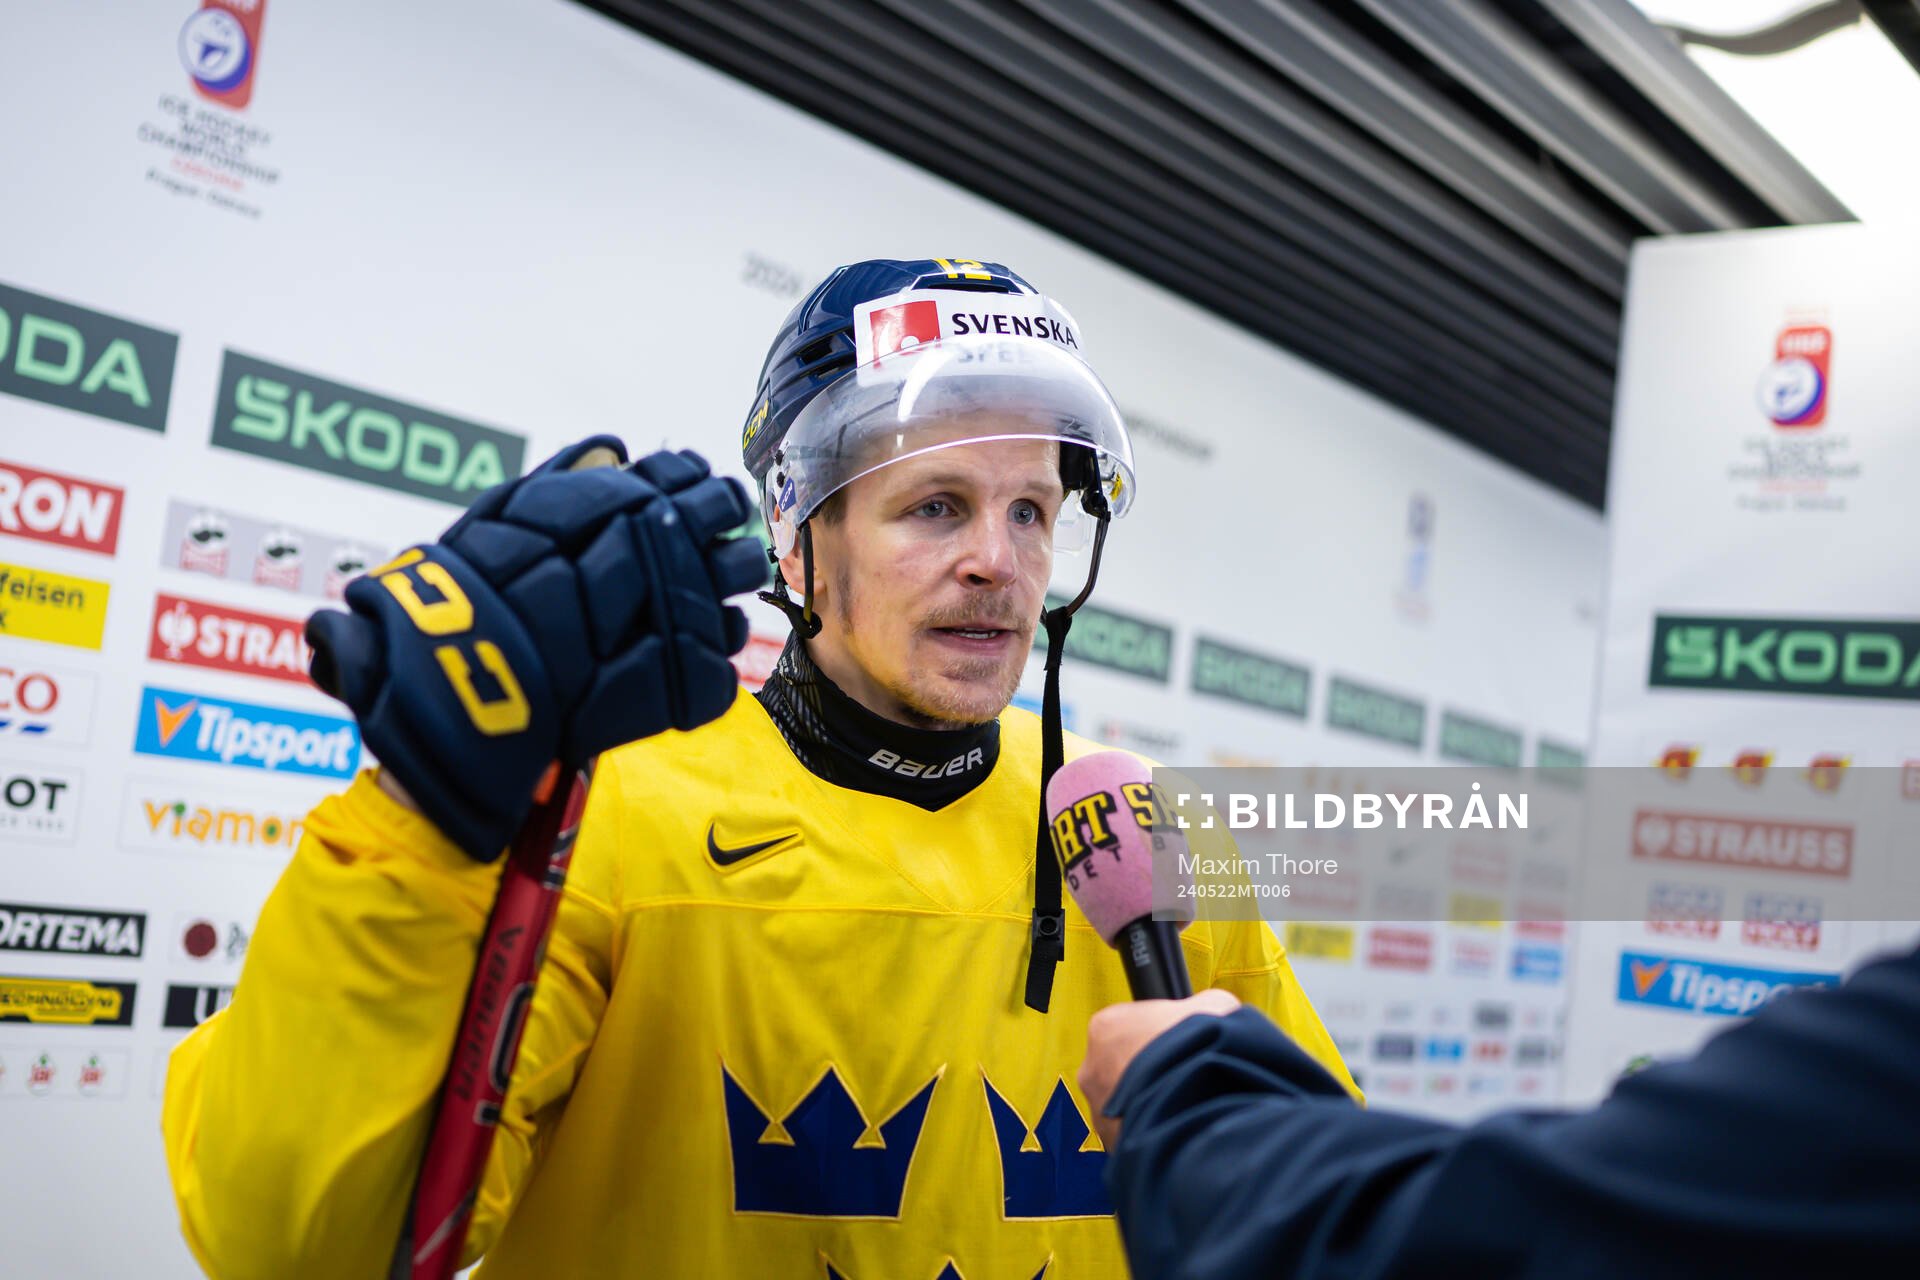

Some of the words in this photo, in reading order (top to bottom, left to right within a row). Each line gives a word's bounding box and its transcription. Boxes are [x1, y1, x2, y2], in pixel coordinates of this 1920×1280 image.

[932, 257, 992, 281] 12
[952, 313, 1079, 350] SVENSKA
[0, 307, 151, 408] DA
[743, 399, 769, 449] CCM
[196, 703, 356, 770] Tipsport
[1051, 790, 1118, 878] RT
[1672, 818, 1846, 870] STRAUSS
[1670, 962, 1826, 1012] Tipsp
